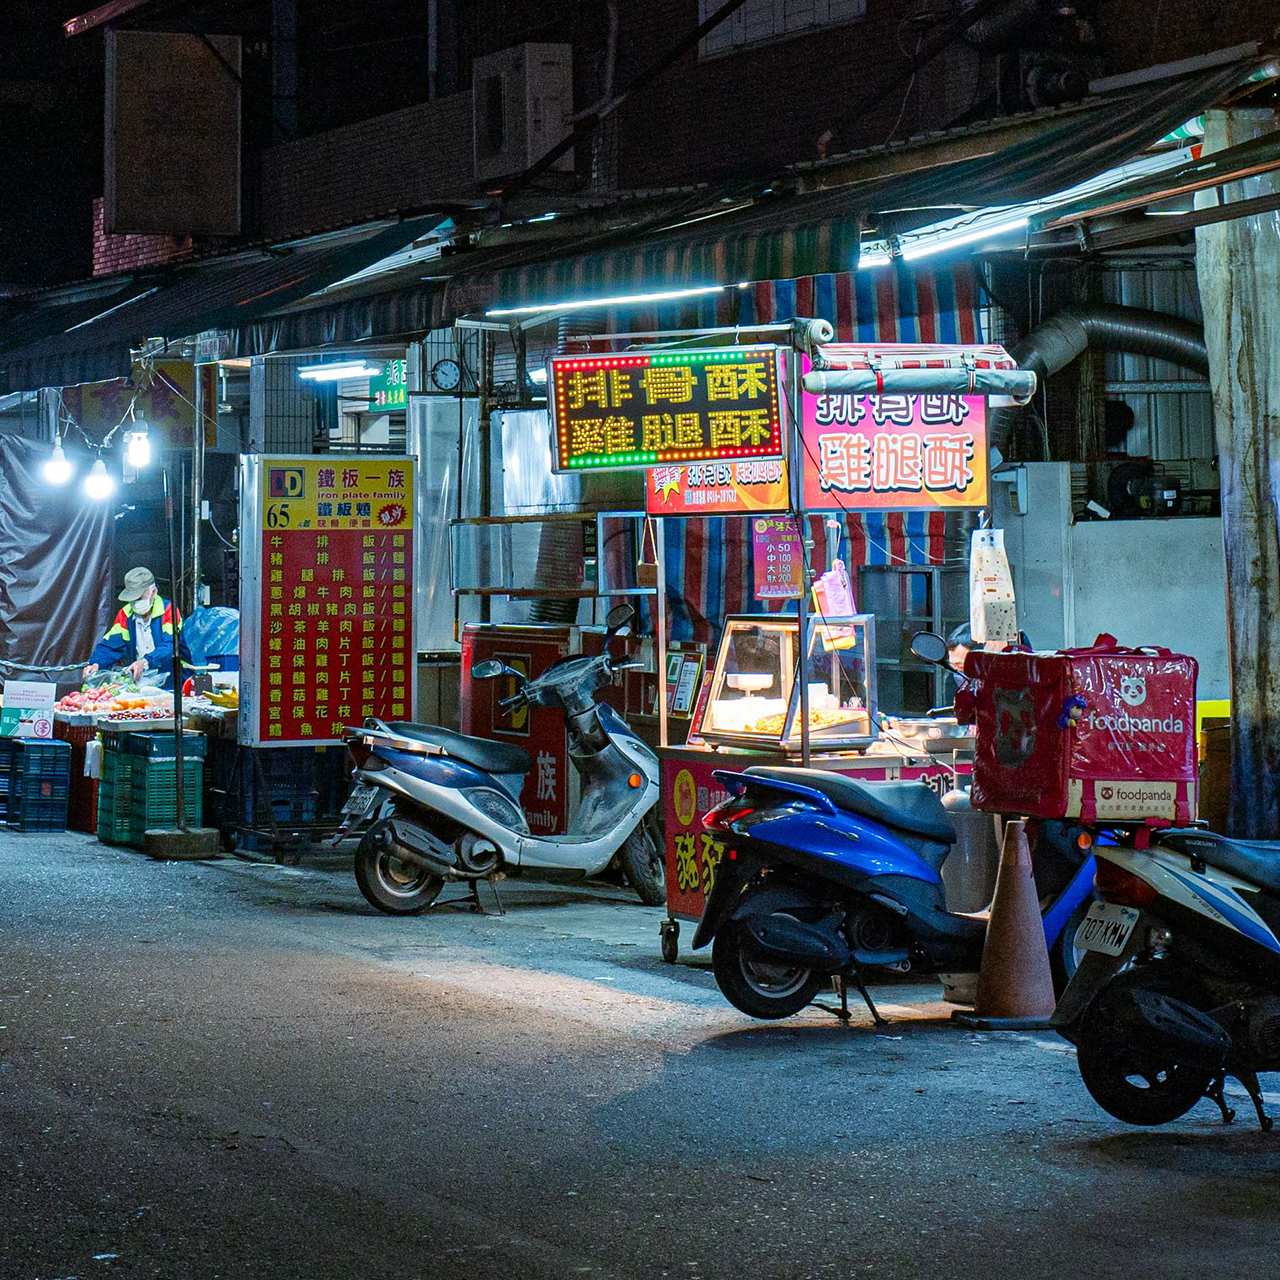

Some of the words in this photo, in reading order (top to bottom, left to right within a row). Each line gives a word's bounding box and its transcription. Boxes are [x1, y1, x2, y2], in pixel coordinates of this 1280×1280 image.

[568, 362, 768, 410] 排骨酥
[569, 409, 771, 457] 雞腿酥
[818, 432, 974, 493] 雞腿酥
[317, 469, 405, 489] 鐵板一族
[317, 491, 339, 499] iron
[342, 491, 370, 500] plate
[373, 491, 406, 501] family
[267, 504, 290, 529] 65
[317, 502, 371, 517] 鐵板燒
[767, 544, 776, 552] 小
[778, 544, 791, 552] 50
[767, 554, 776, 562] 中
[778, 554, 791, 562] 100
[767, 565, 776, 573] 大
[778, 565, 791, 573] 150
[778, 575, 791, 583] 200
[1089, 711, 1184, 735] foodpanda
[1117, 788, 1172, 803] foodpanda
[1185, 838, 1218, 849] SUZUKI
